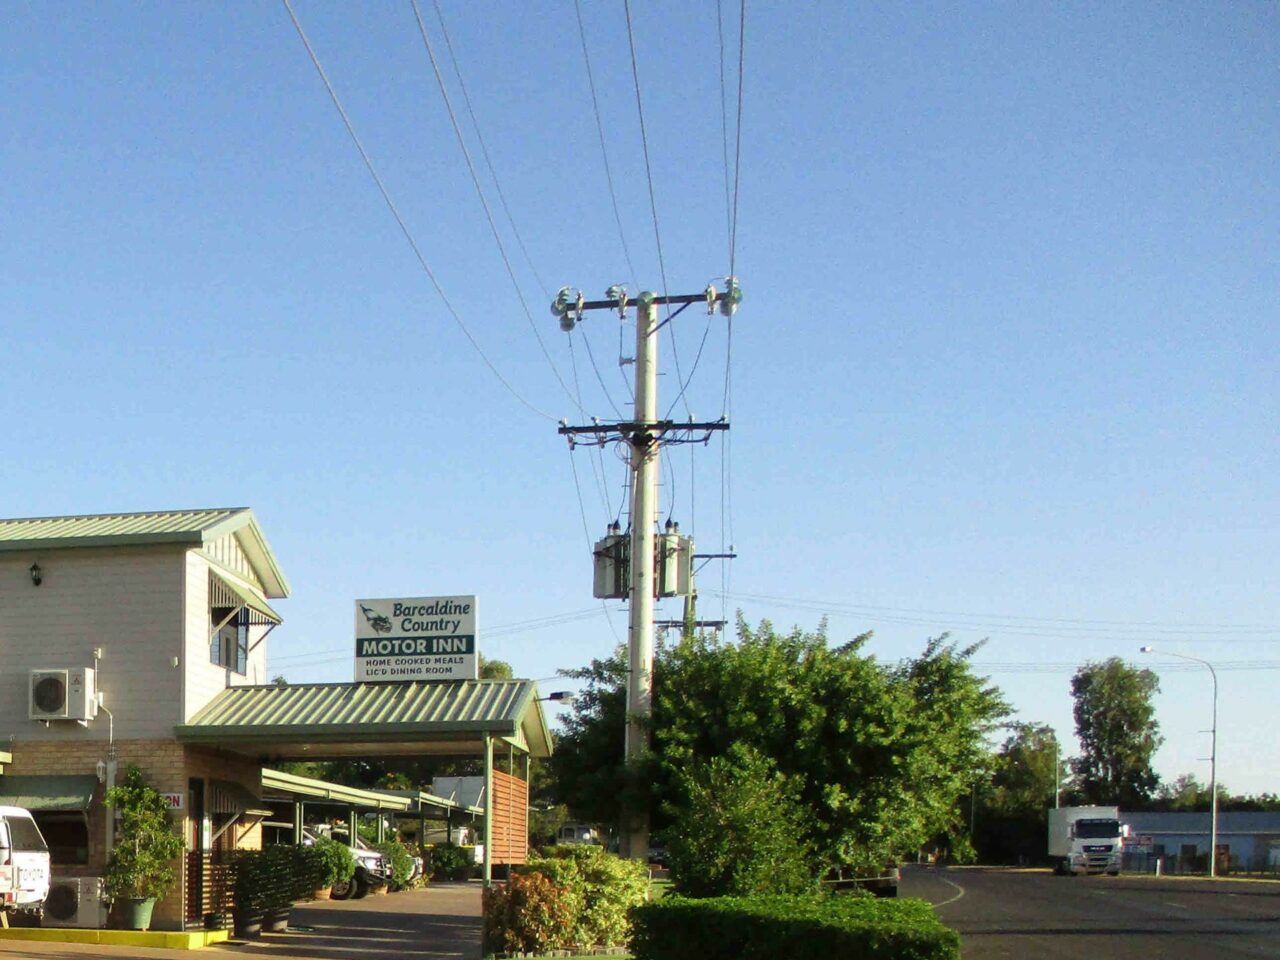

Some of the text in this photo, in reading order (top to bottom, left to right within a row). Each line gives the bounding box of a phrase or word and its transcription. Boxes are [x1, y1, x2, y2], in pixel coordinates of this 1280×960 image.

[393, 600, 470, 617] Barcaldine
[401, 617, 461, 633] Country
[362, 638, 466, 654] MOTOR INN
[395, 657, 431, 666] COOKED
[434, 656, 464, 665] MEALS
